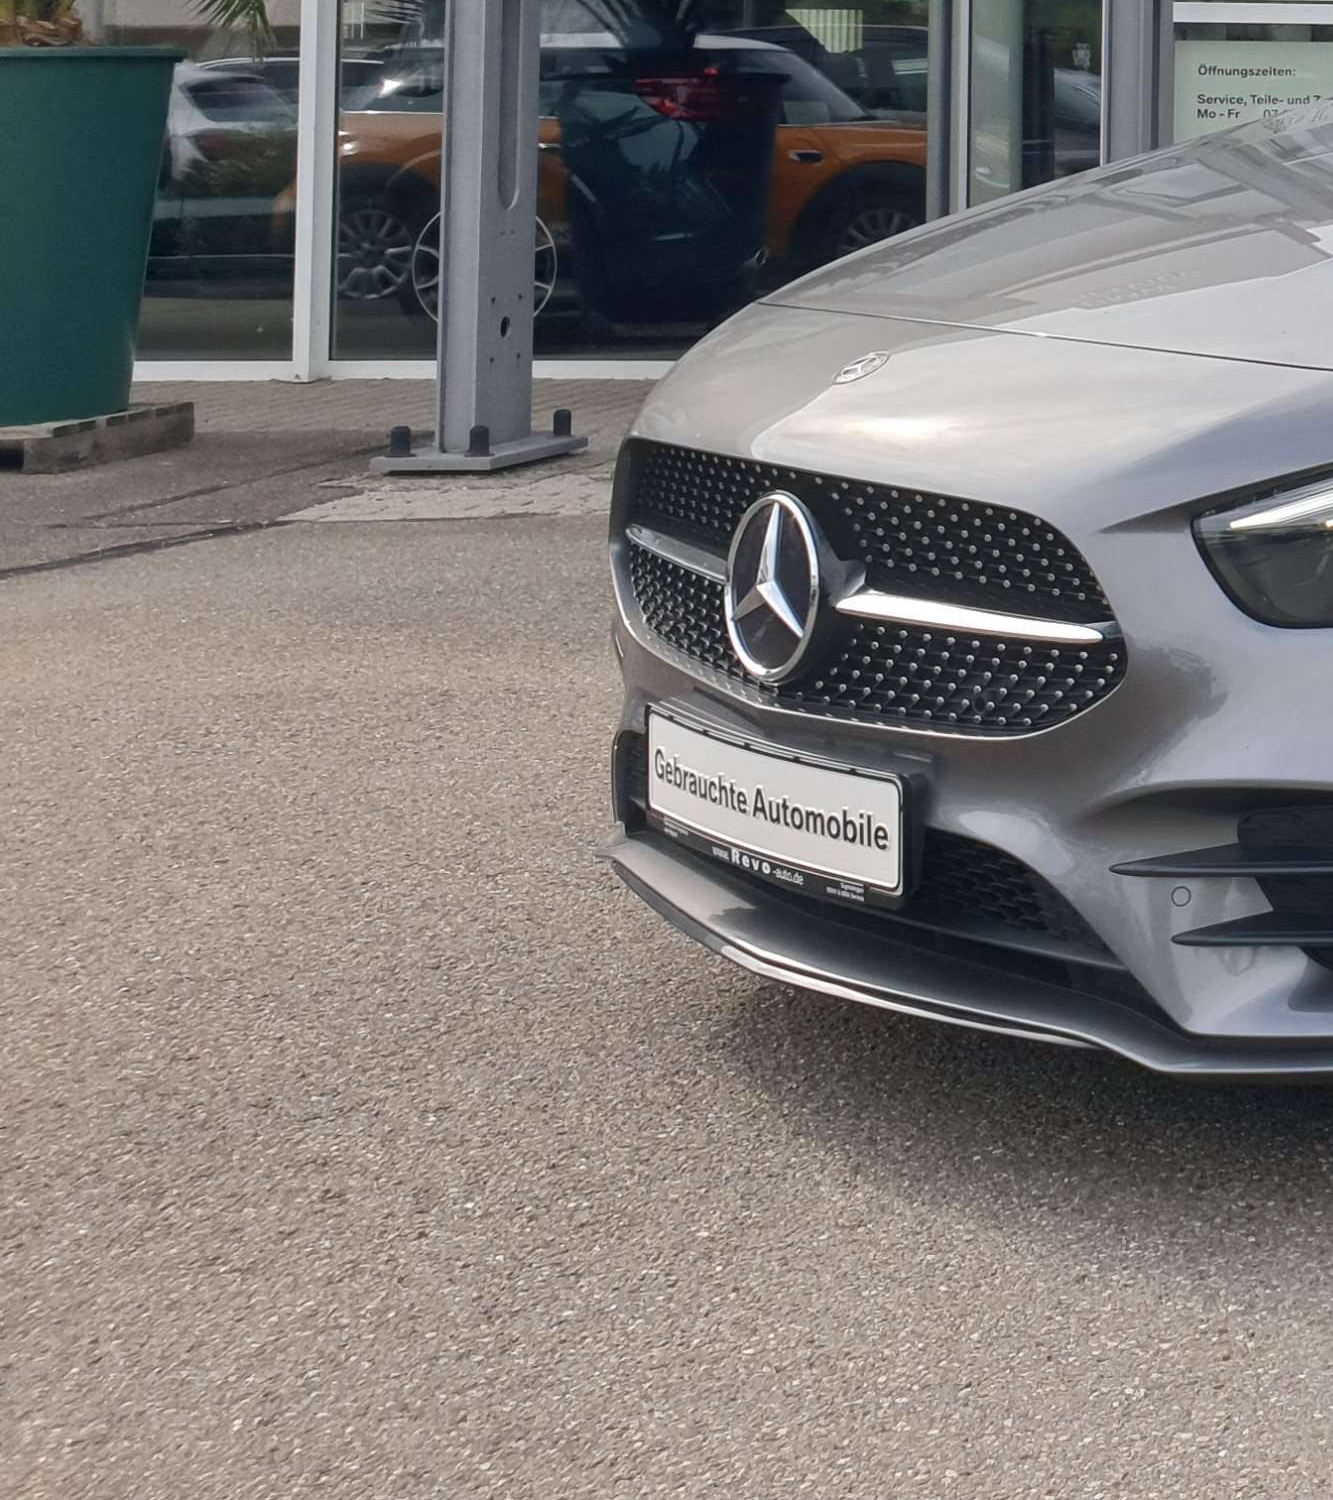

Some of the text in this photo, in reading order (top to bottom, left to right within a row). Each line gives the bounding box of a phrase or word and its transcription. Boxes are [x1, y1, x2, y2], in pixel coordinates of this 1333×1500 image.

[1197, 63, 1297, 79] Öffnungszeiten:
[1196, 94, 1248, 107] Service,
[1250, 94, 1285, 106] Teile-
[1287, 95, 1311, 106] und
[1196, 108, 1217, 119] Mo
[1227, 108, 1241, 119] Fr
[653, 747, 889, 851] Gebrauchte Automobile
[730, 848, 771, 875] Revo
